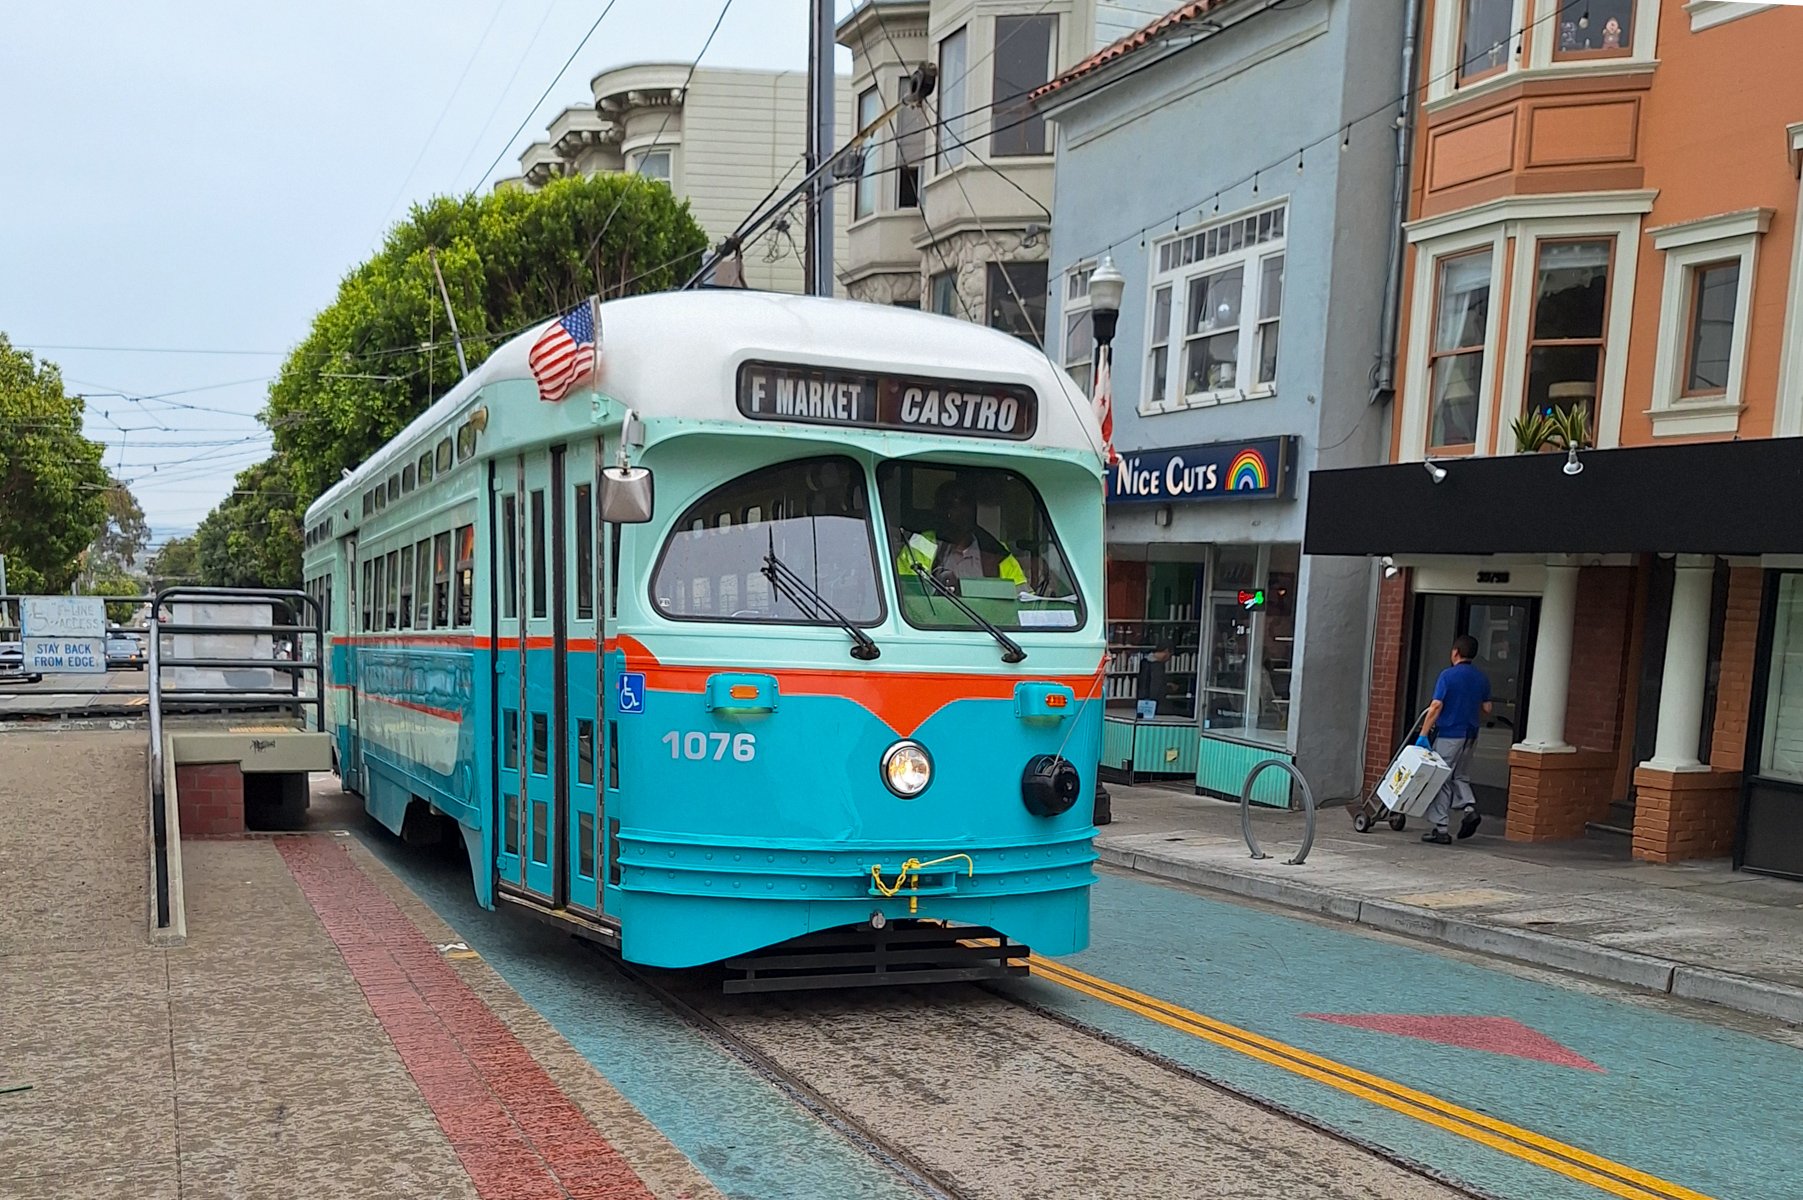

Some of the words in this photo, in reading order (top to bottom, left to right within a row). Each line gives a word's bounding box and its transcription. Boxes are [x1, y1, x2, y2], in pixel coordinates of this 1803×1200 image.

[751, 376, 767, 413] F
[775, 378, 861, 421] MARKET
[899, 387, 1018, 433] CASTRO
[59, 618, 99, 630] ACCESS
[36, 643, 60, 655] STAY
[64, 643, 92, 655] BACK
[34, 656, 64, 667] FROM
[68, 656, 95, 667] EDGE
[662, 730, 756, 762] 1076
